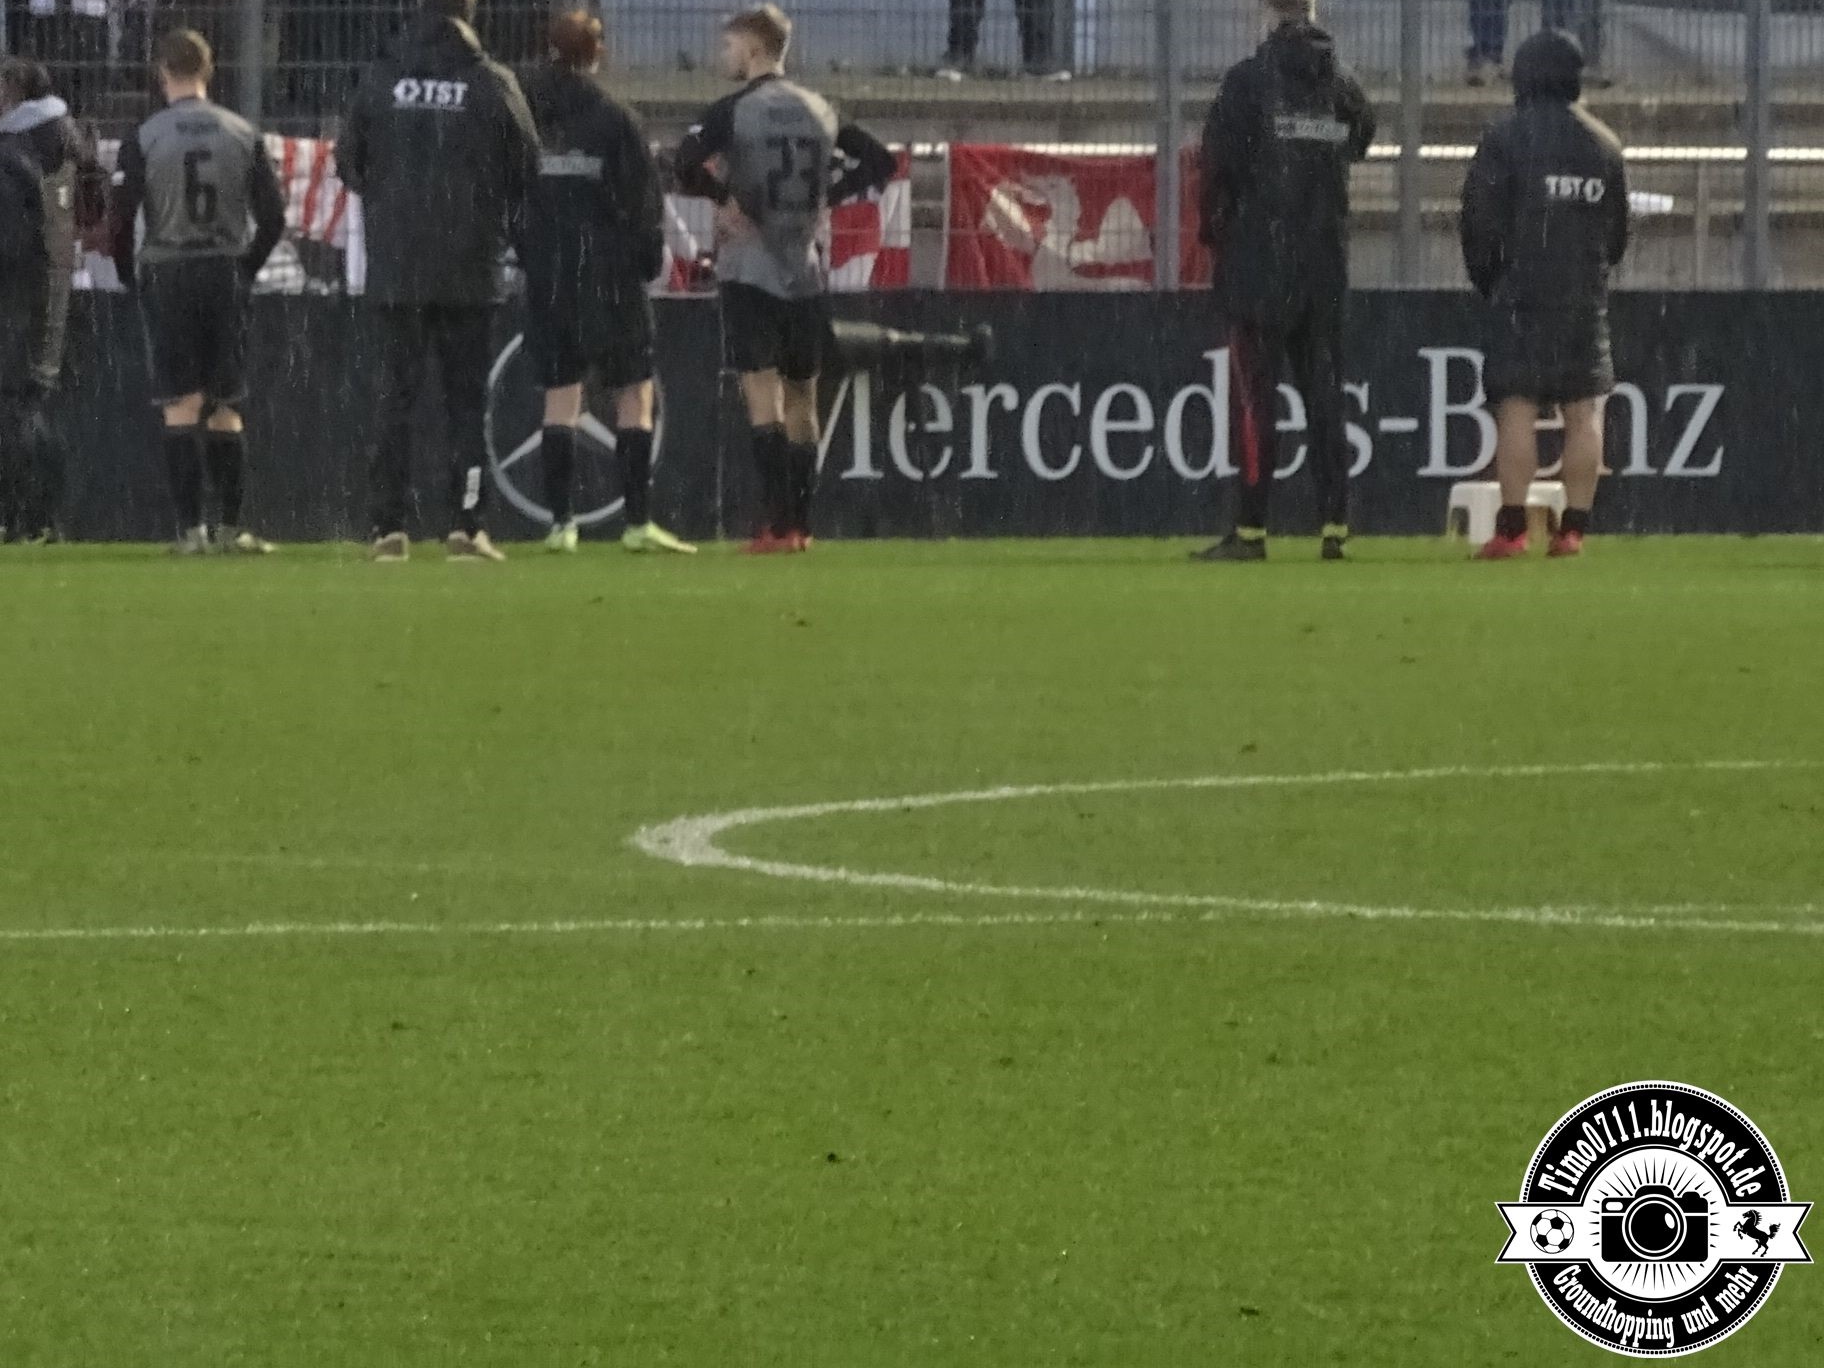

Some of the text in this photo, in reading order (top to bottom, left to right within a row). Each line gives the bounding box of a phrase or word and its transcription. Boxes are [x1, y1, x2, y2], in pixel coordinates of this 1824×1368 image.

[422, 79, 469, 105] TST
[183, 150, 217, 224] 6
[766, 135, 821, 210] 23
